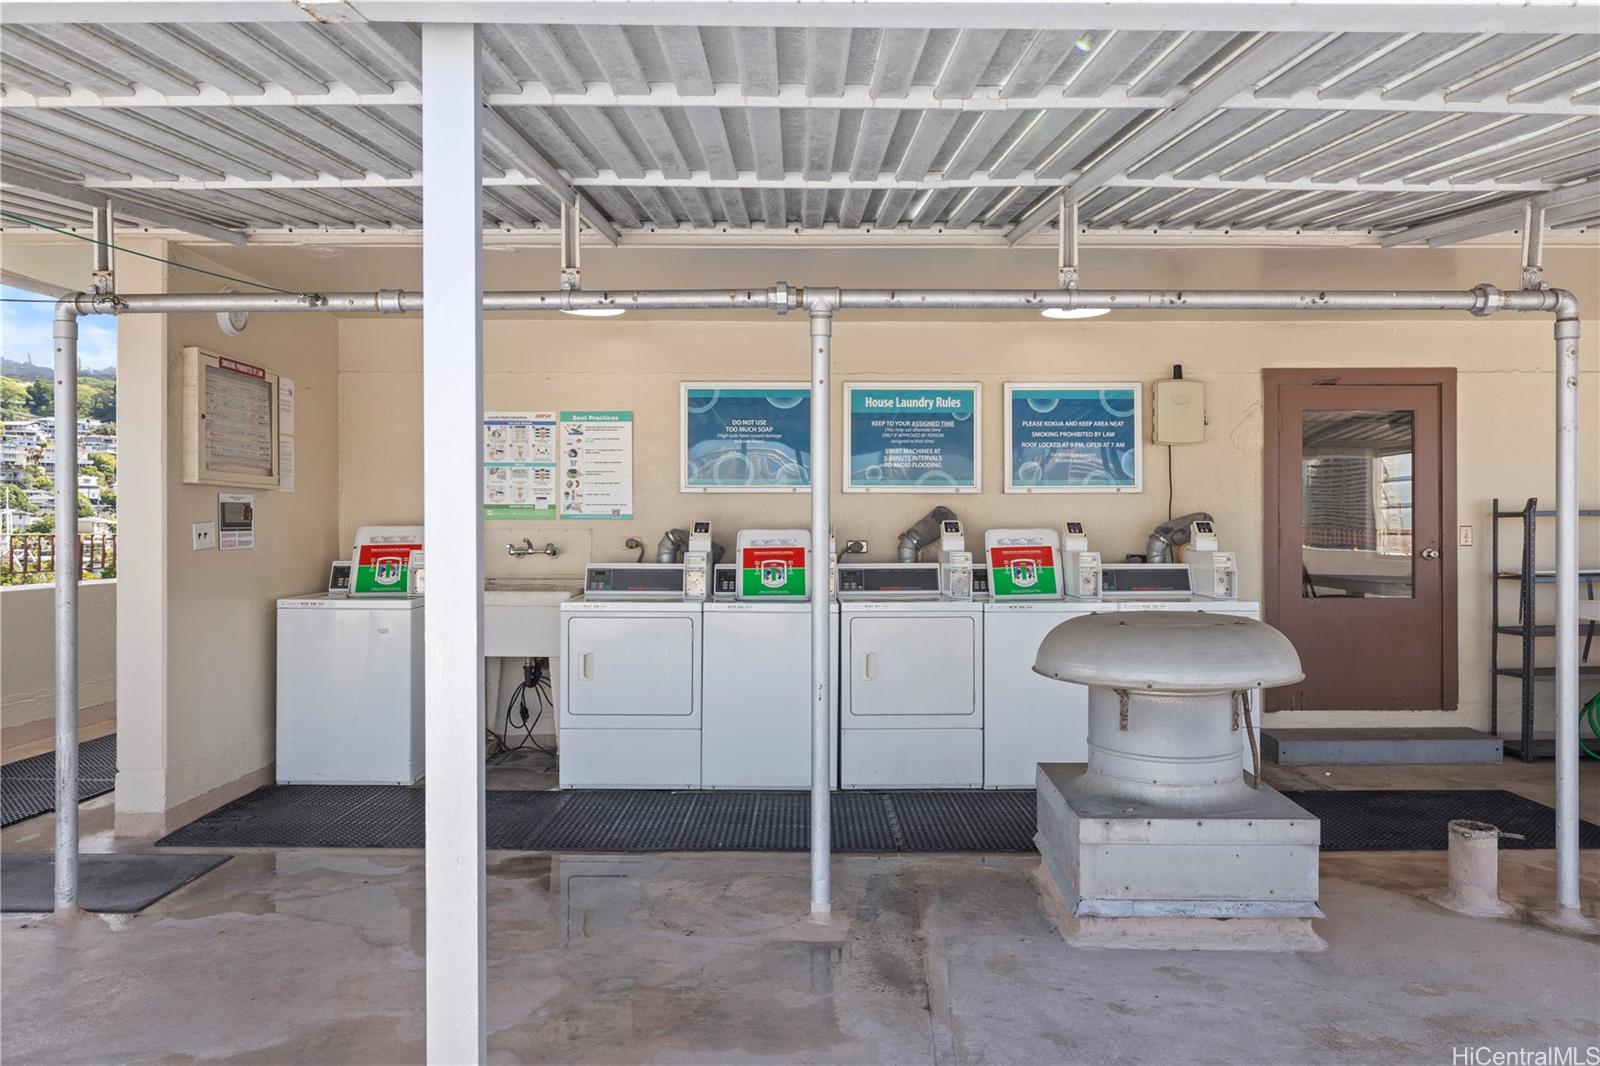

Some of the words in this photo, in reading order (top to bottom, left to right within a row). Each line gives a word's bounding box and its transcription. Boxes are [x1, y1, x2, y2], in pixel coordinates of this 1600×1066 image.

[865, 397, 894, 408] House
[895, 397, 934, 410] Laundry
[936, 397, 961, 408] Rules
